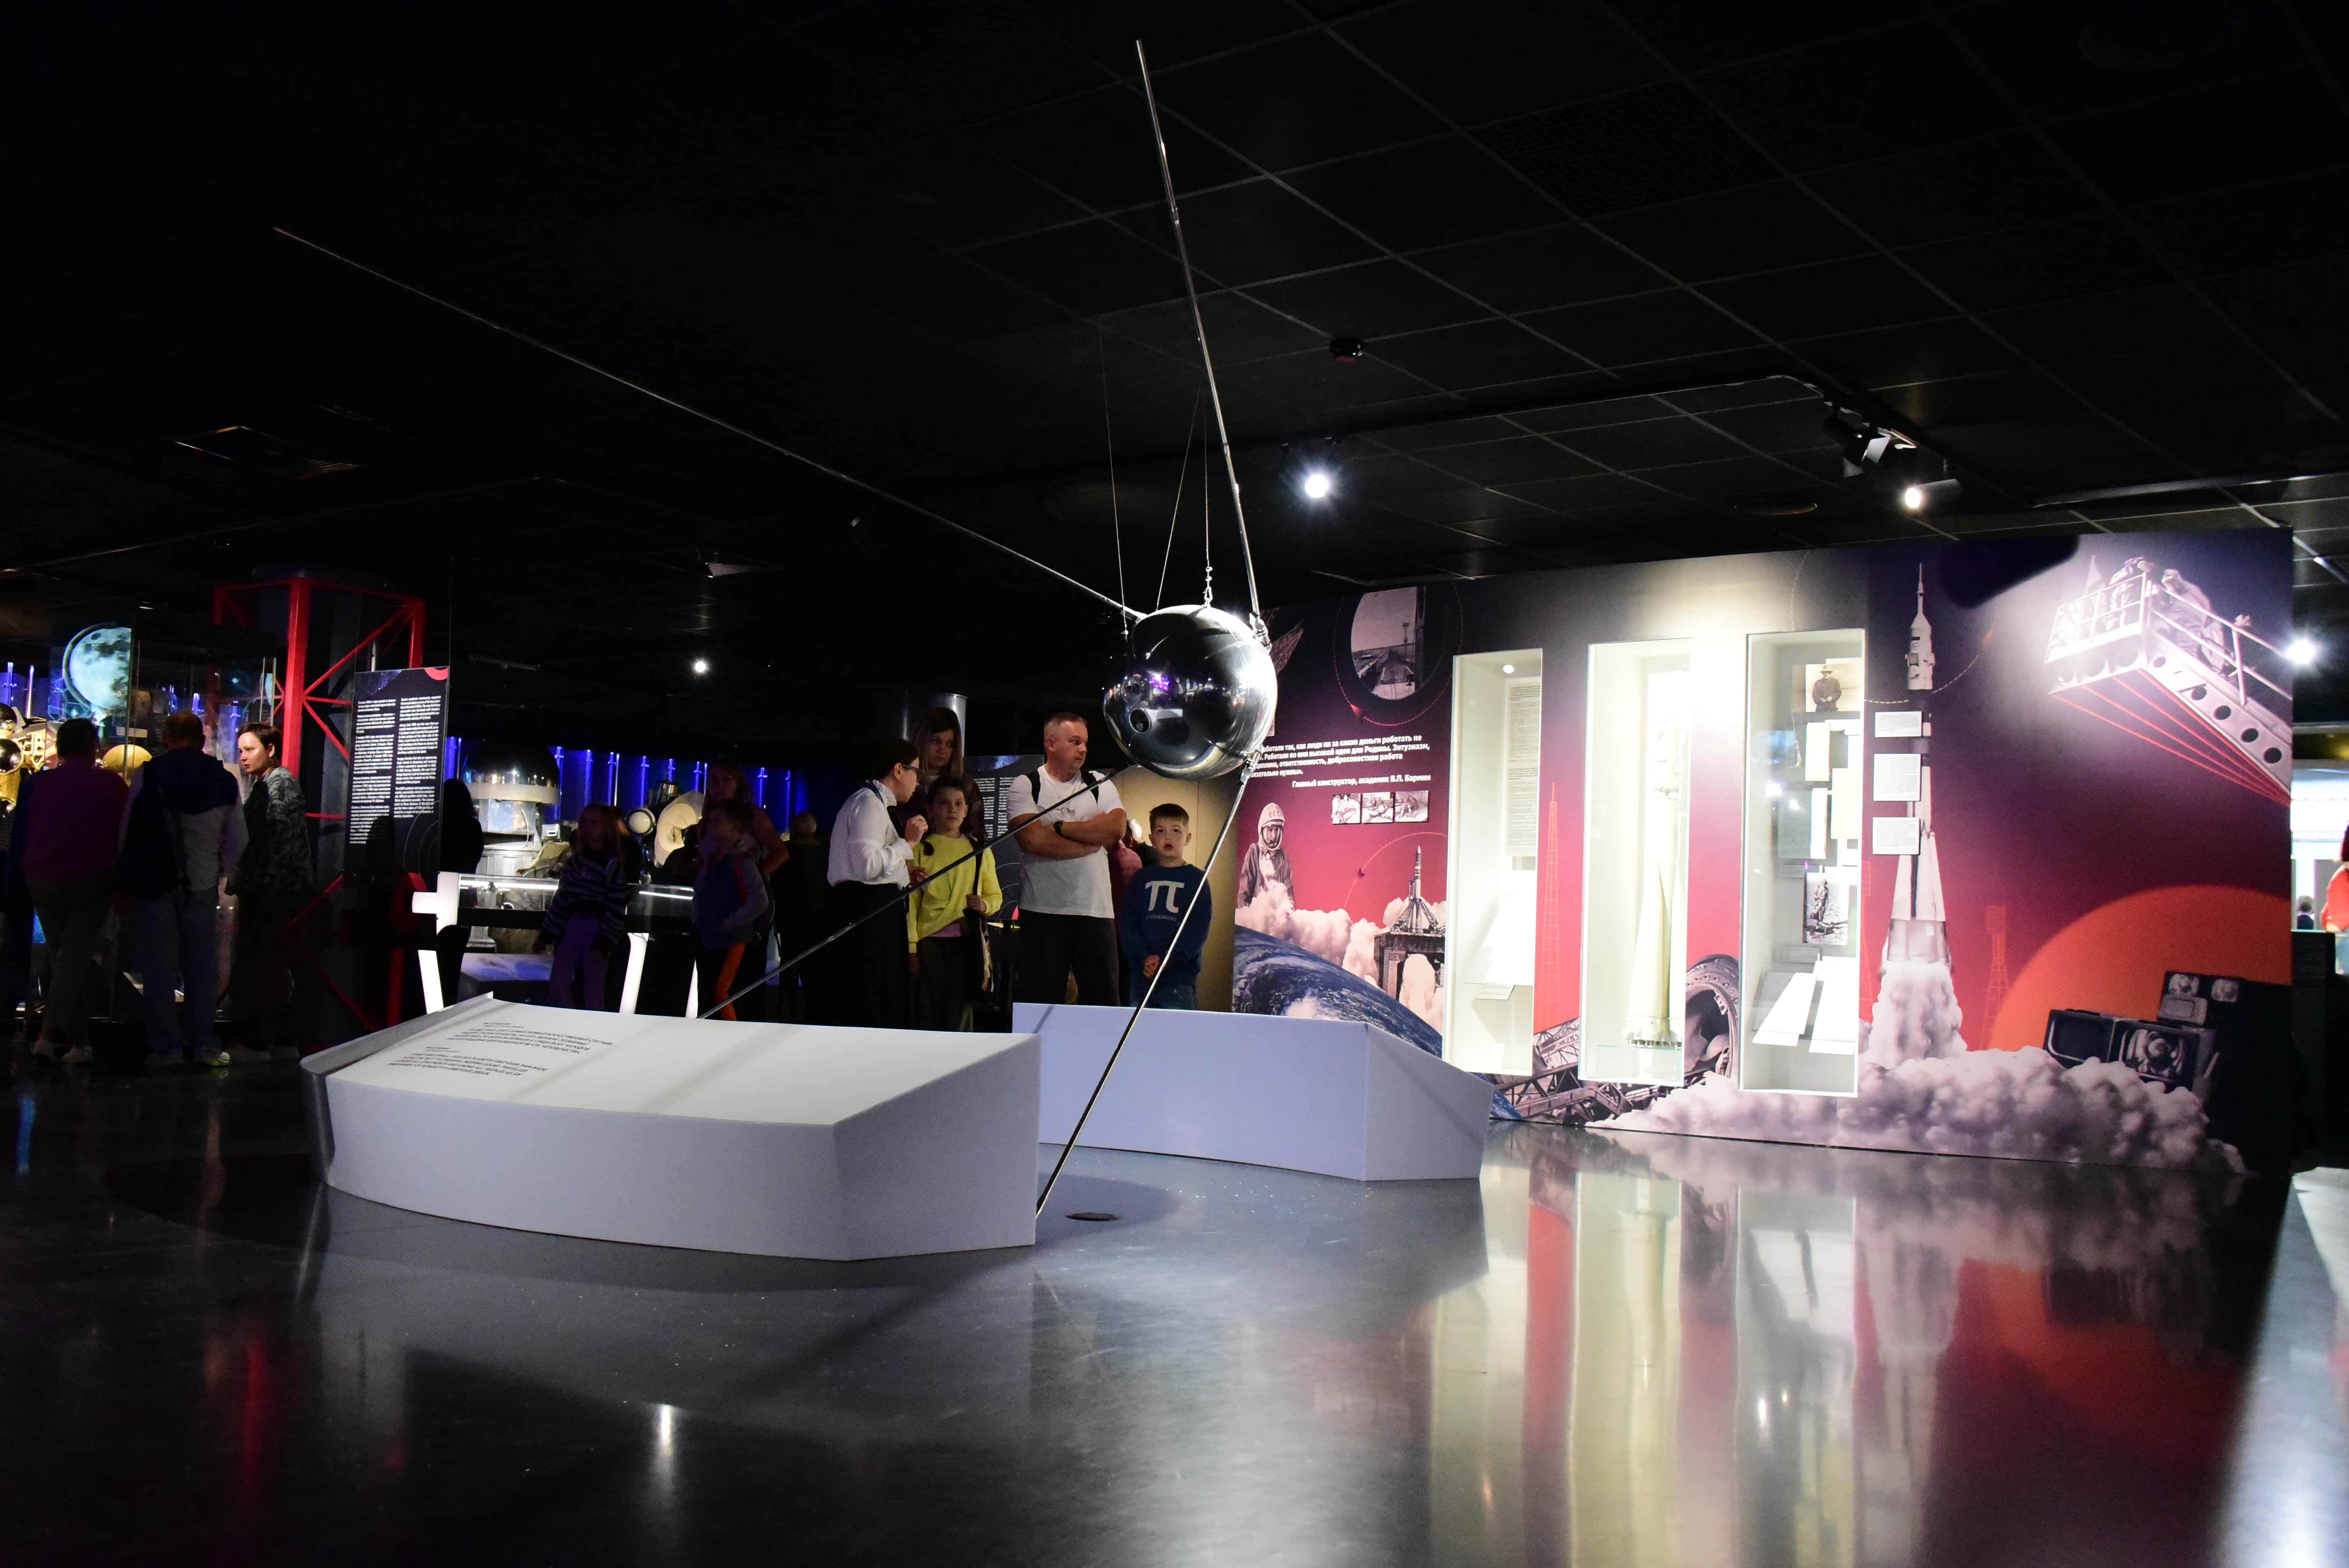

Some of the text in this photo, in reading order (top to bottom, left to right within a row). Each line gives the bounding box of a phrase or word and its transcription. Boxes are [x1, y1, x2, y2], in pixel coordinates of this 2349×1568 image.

[1262, 745, 1284, 753] аботали
[1359, 738, 1381, 746] деньги
[1382, 735, 1412, 745] работать
[1309, 748, 1335, 757] высокой
[1365, 745, 1391, 754] Родины.
[1392, 743, 1430, 752] Энтузиазм,
[1279, 759, 1326, 768] ответственность,
[1327, 754, 1379, 764] добросовестная
[1379, 752, 1403, 762] работа
[1292, 779, 1316, 788] Главный
[1317, 777, 1358, 787] конструктор,
[1358, 776, 1390, 784] академик
[1404, 774, 1431, 783] Бармин
